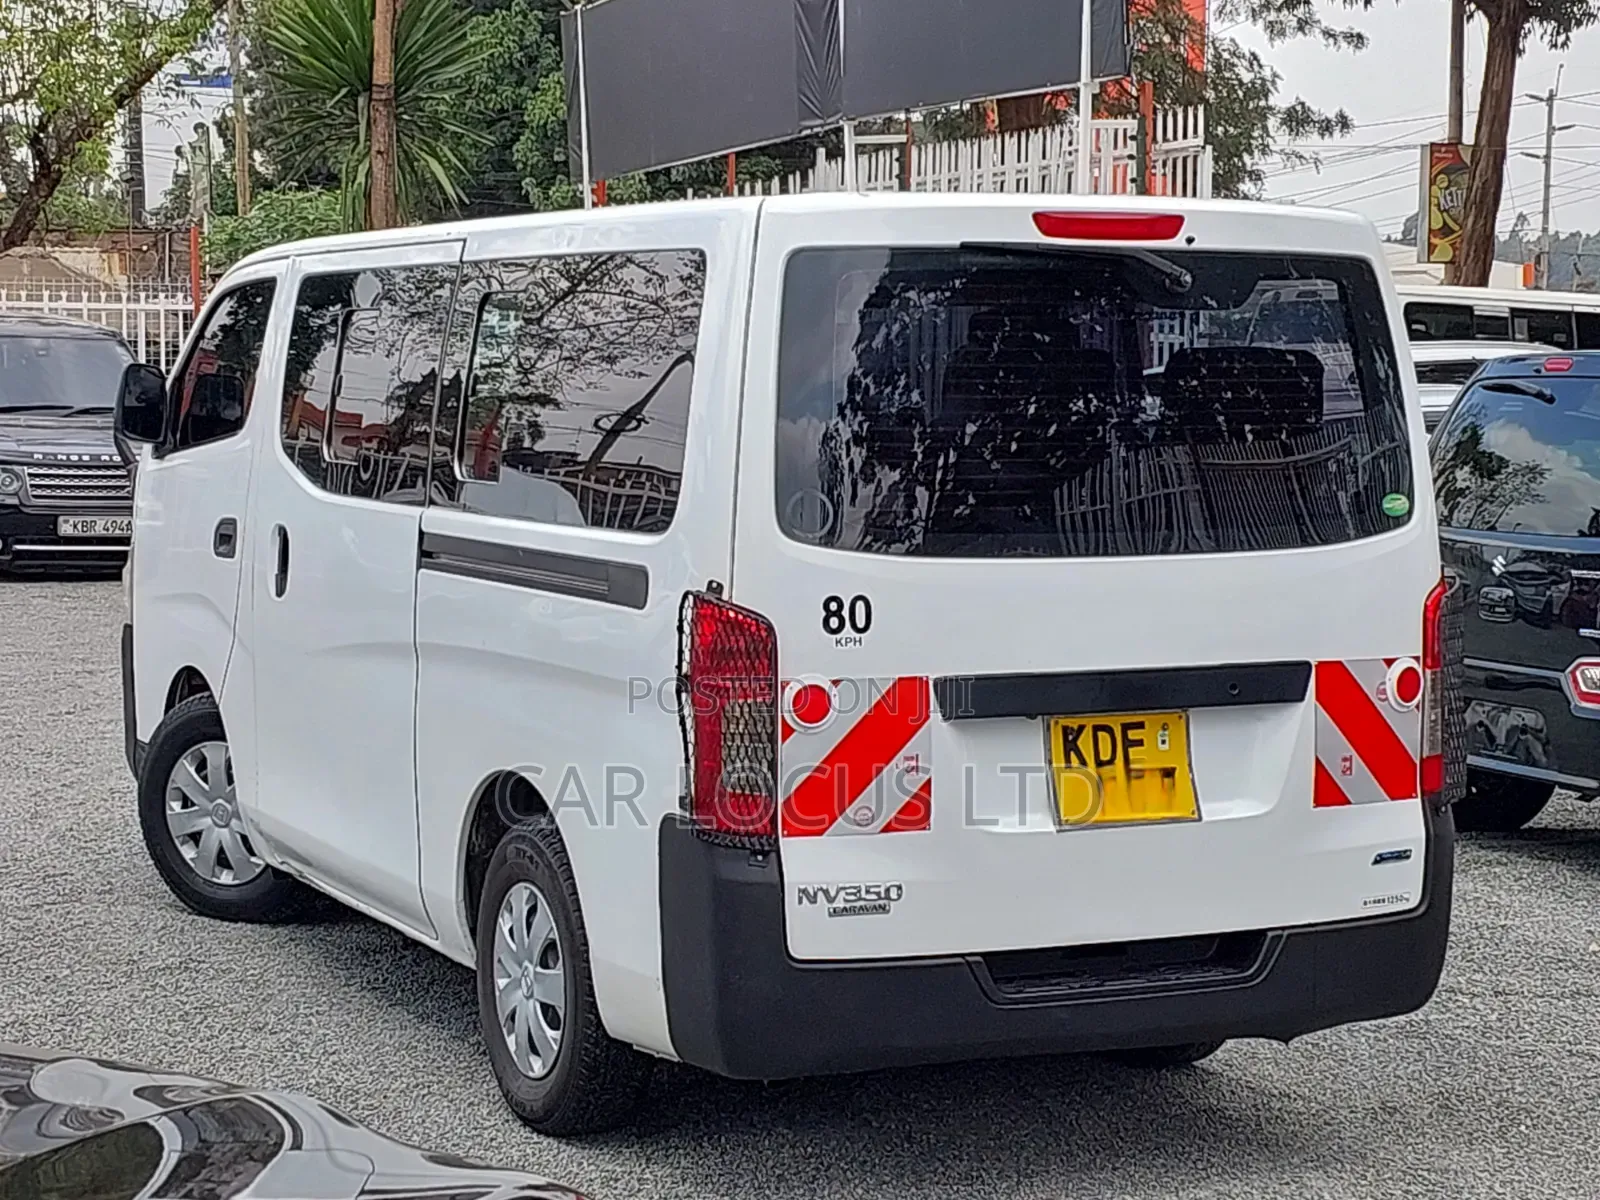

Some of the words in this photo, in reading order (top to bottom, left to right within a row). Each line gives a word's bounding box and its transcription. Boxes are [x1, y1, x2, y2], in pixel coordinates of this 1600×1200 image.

[72, 520, 98, 533] KBR
[102, 520, 134, 533] 494A
[822, 594, 872, 635] 80
[835, 637, 862, 647] KPH
[797, 883, 903, 905] NV350
[832, 903, 887, 914] CARAVAN
